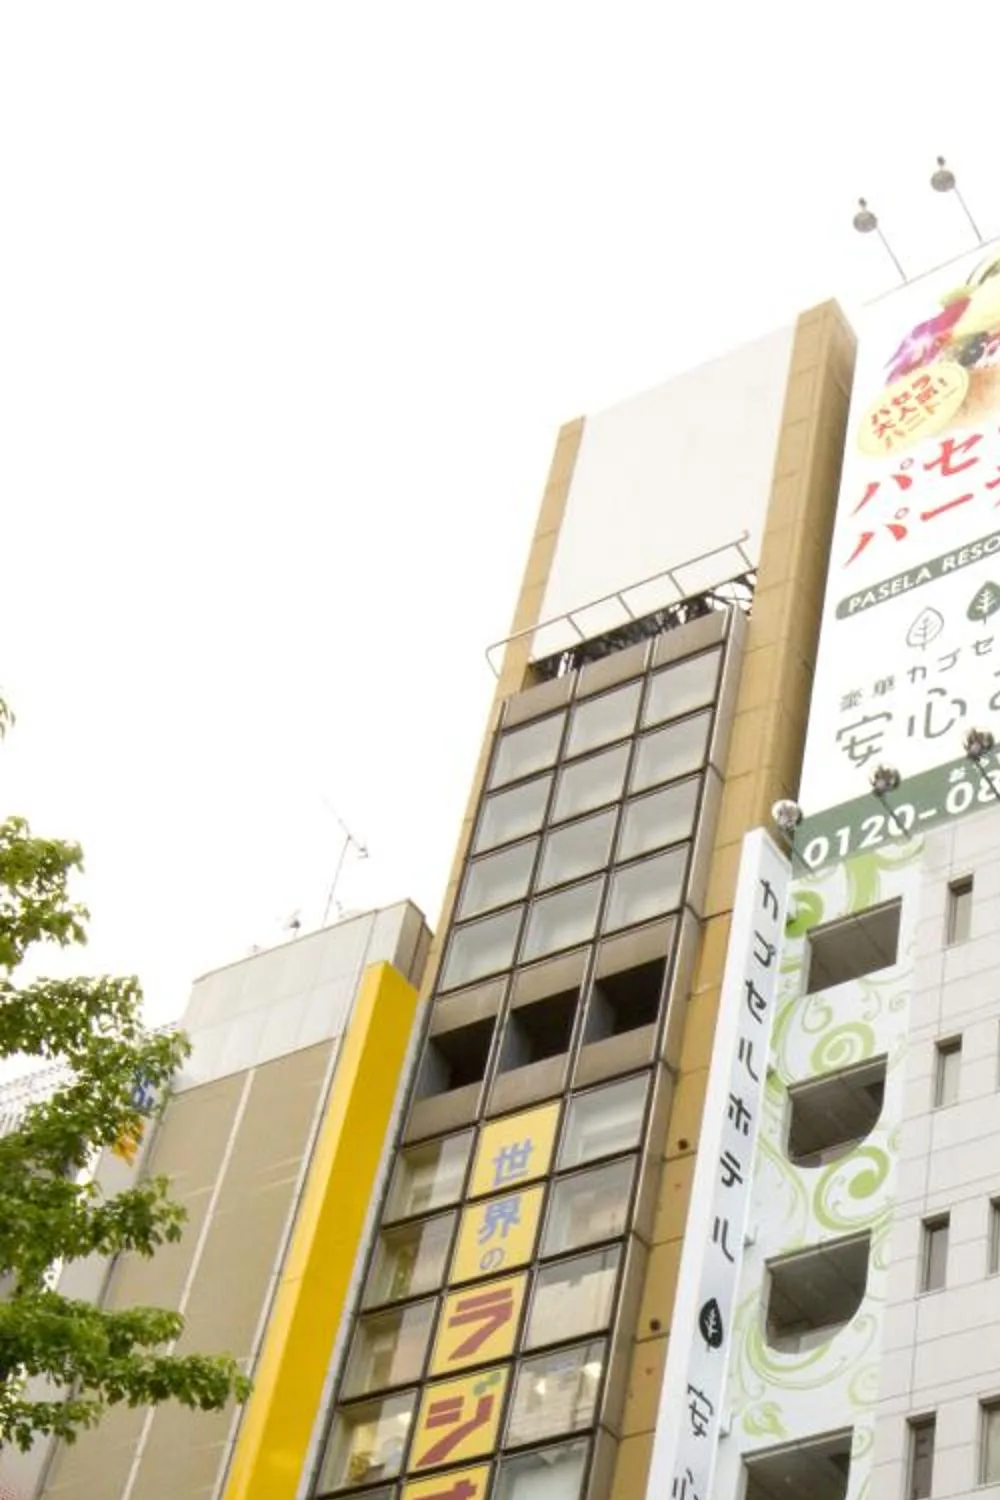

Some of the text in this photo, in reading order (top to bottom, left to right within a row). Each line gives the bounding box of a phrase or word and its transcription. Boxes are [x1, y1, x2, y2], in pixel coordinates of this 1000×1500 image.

[847, 566, 933, 614] PASELA
[712, 878, 778, 1264] カプセルホテル
[477, 1137, 534, 1272] 世界の
